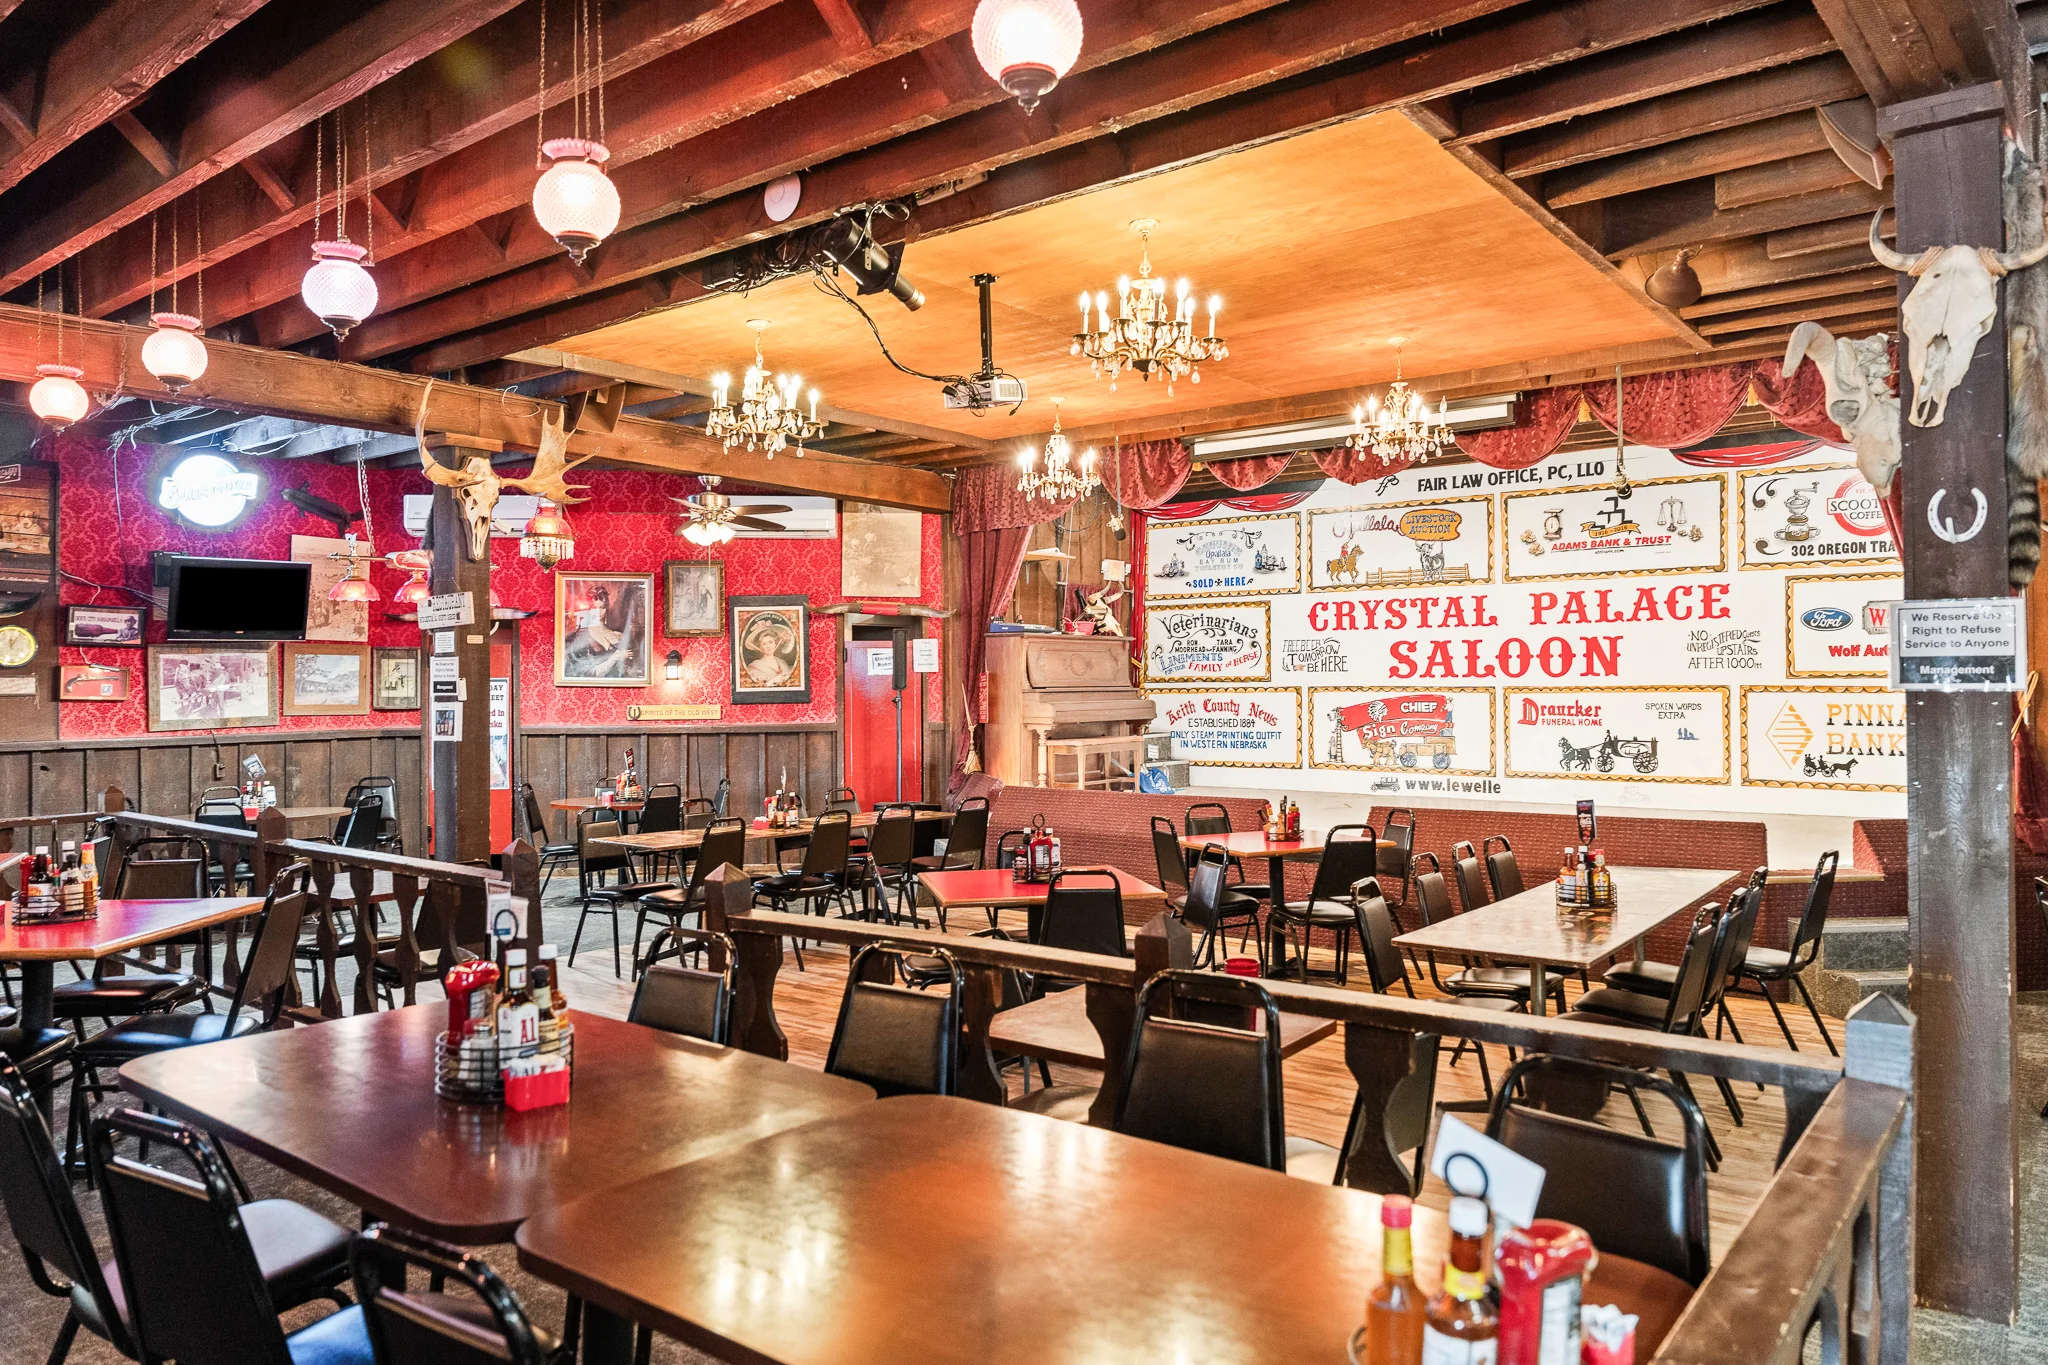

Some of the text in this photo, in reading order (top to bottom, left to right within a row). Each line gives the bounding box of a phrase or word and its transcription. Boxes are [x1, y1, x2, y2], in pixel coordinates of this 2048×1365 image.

[1417, 460, 1605, 493] FAIR LAW OFFICE, PC, LLO
[1405, 512, 1458, 524] LIVESTOCK
[1849, 510, 1884, 520] COFFE
[1408, 523, 1452, 535] AUCTION
[1551, 535, 1672, 551] ADAMS BANK & TRUST
[1791, 544, 1815, 557] 302
[1818, 541, 1867, 556] OREGON
[1219, 556, 1239, 564] RUM
[1192, 576, 1246, 589] SOLD HERE
[1307, 583, 1731, 632] CRYSTAL PALACE
[1810, 611, 1842, 628] Ford
[1911, 613, 1929, 622] We
[1932, 612, 1979, 621] Reserve
[1154, 613, 1258, 640] Veterinarians
[1912, 626, 2002, 637] Right to Refuse
[1690, 630, 1709, 641] NO
[1905, 639, 2010, 650] Service to Anyone
[1287, 644, 1341, 666] TOMORROW
[1828, 645, 1860, 657] Wolf
[1159, 652, 1224, 670] LINIMENTS
[1188, 661, 1223, 673] FAMILY
[1233, 650, 1259, 667] HORSE
[1388, 636, 1624, 679] SALOON
[1687, 657, 1725, 669] AFTER
[1307, 655, 1349, 673] BE HERE
[1920, 665, 1995, 676] Management
[1401, 702, 1438, 713] CHIEF
[1517, 697, 1602, 726] Draucker
[1645, 702, 1703, 710] SPOKEN WORDS
[1203, 698, 1240, 716] County
[1248, 702, 1279, 727] News
[1658, 711, 1686, 719] EXTRA
[1188, 718, 1238, 728] ESTABLISHED
[1541, 718, 1603, 727] FUNERAL HOME
[1170, 731, 1282, 740] ONLY STEAM PRINTING OUTFIT
[1363, 720, 1439, 739] Sign Company
[1180, 740, 1268, 749] IN WESTERN NEBRASKA
[1826, 732, 1907, 757] BANK
[520, 1016, 537, 1044] A1
